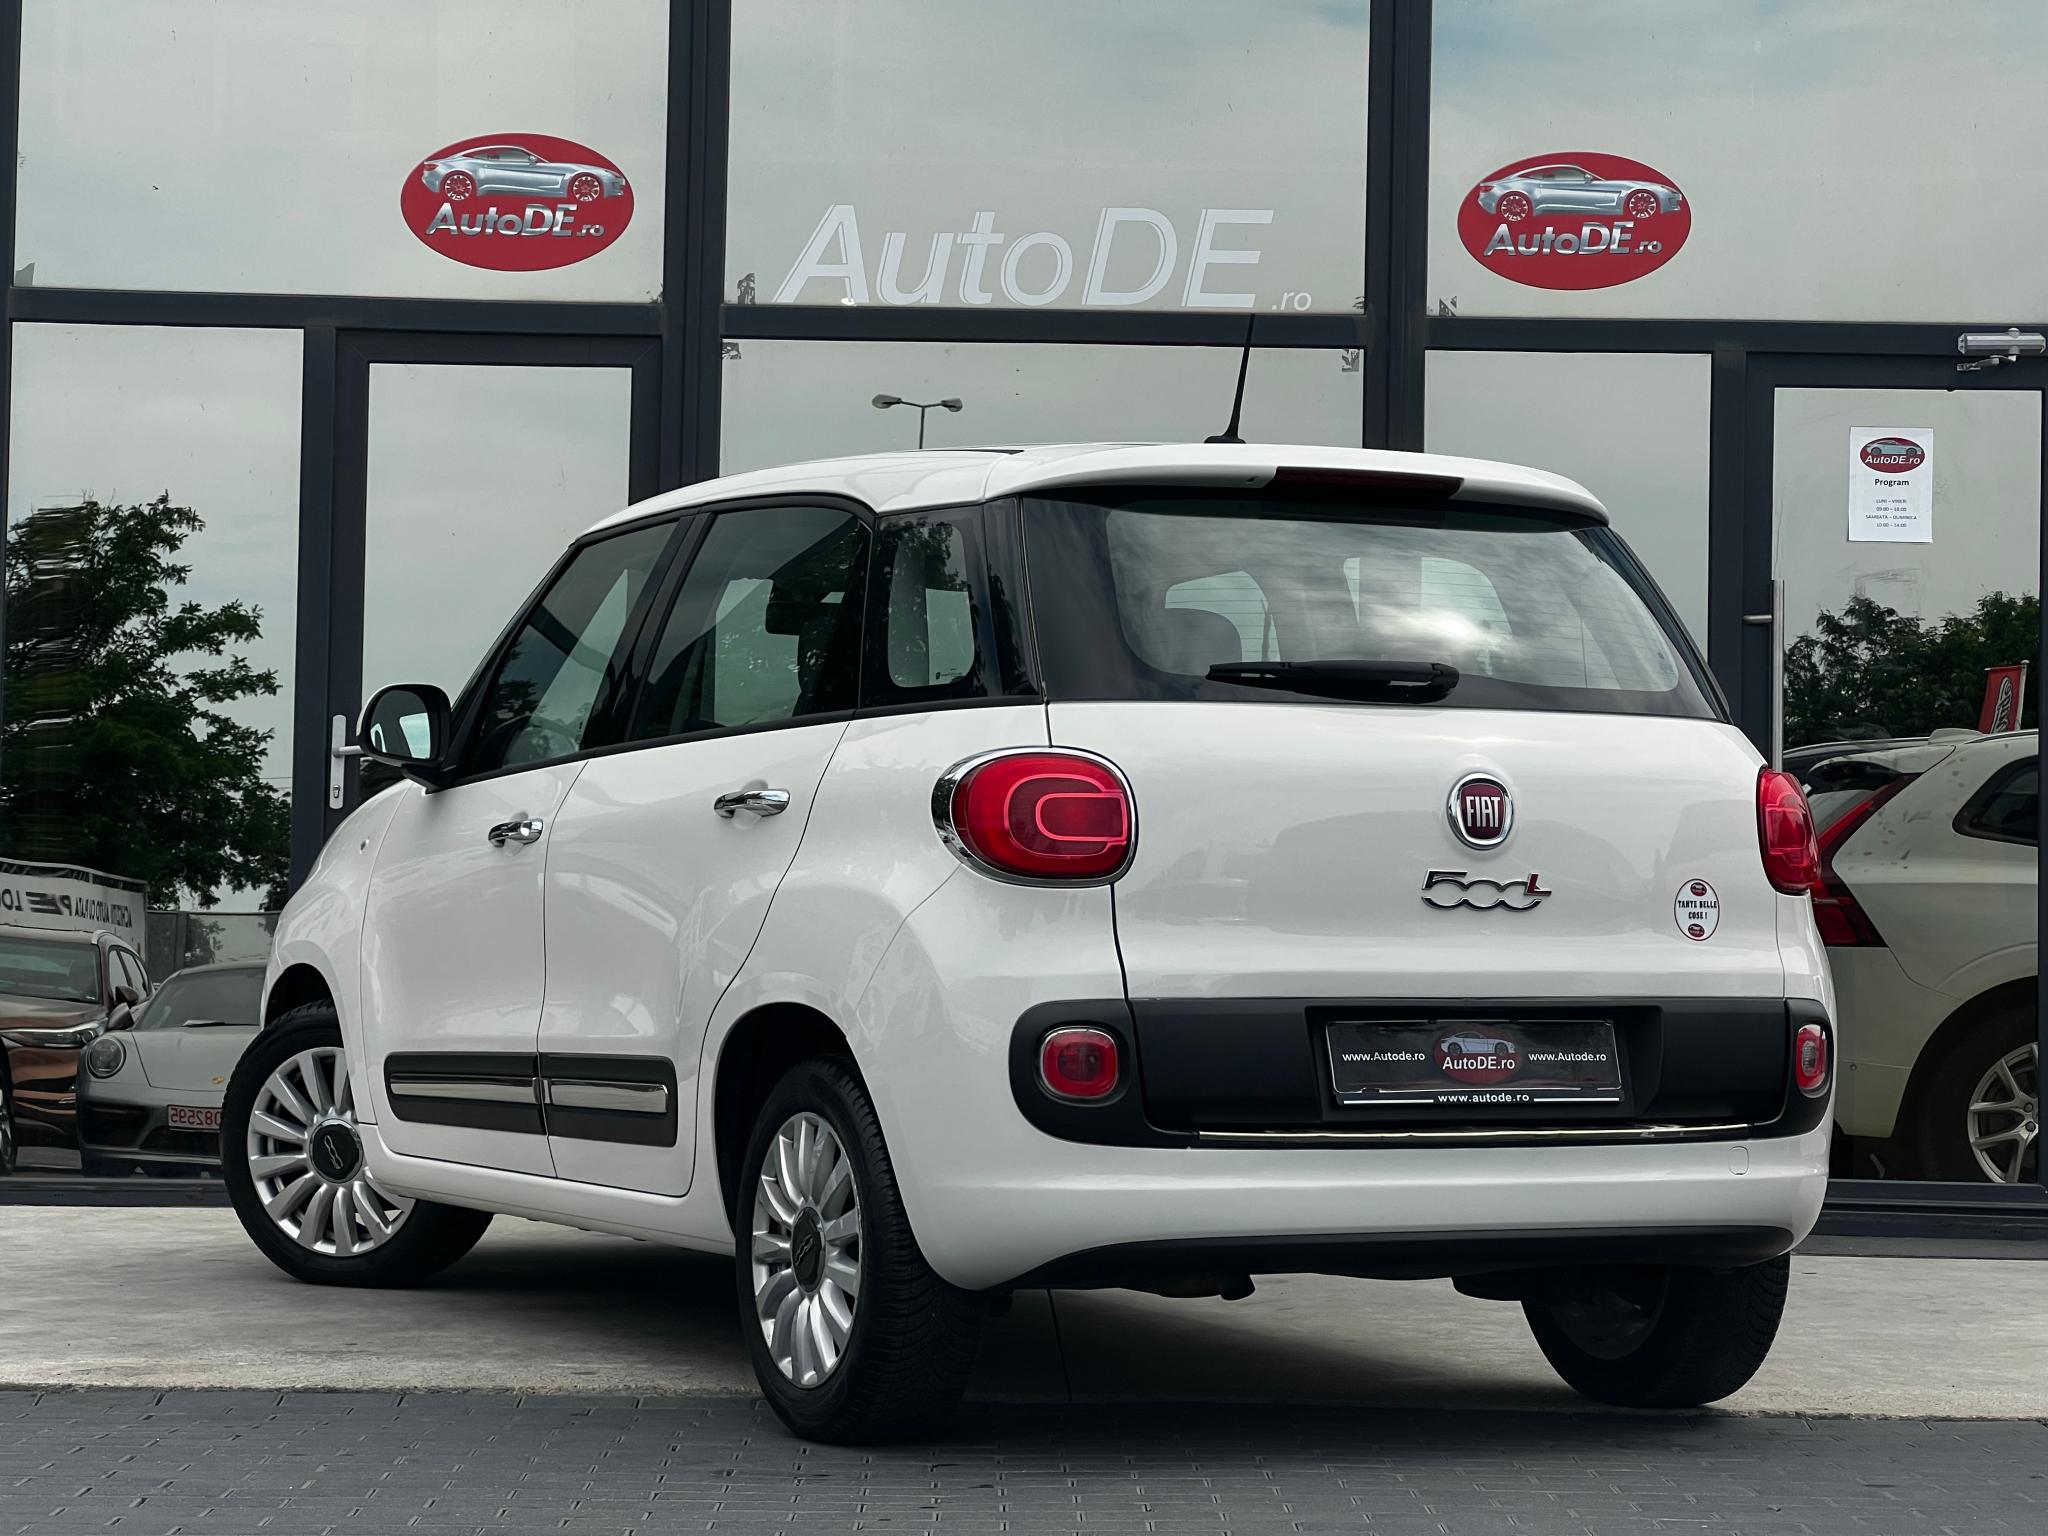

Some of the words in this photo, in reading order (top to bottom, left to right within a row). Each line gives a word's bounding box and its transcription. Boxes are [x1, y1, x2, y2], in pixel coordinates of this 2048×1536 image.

[1865, 455, 1921, 465] AutoDE.ro
[1874, 478, 1910, 487] Program
[1465, 795, 1501, 828] FIAT
[1421, 868, 1553, 912] 500L
[1677, 900, 1697, 909] TANTE
[1699, 900, 1717, 909] BELLE
[1688, 911, 1703, 920] COSE
[1341, 1051, 1426, 1062] www.Autode.ro
[1442, 1056, 1516, 1071] AutoDE.ro
[1528, 1051, 1607, 1062] www.Autode.ro
[1437, 1093, 1530, 1104] www.autode.ro
